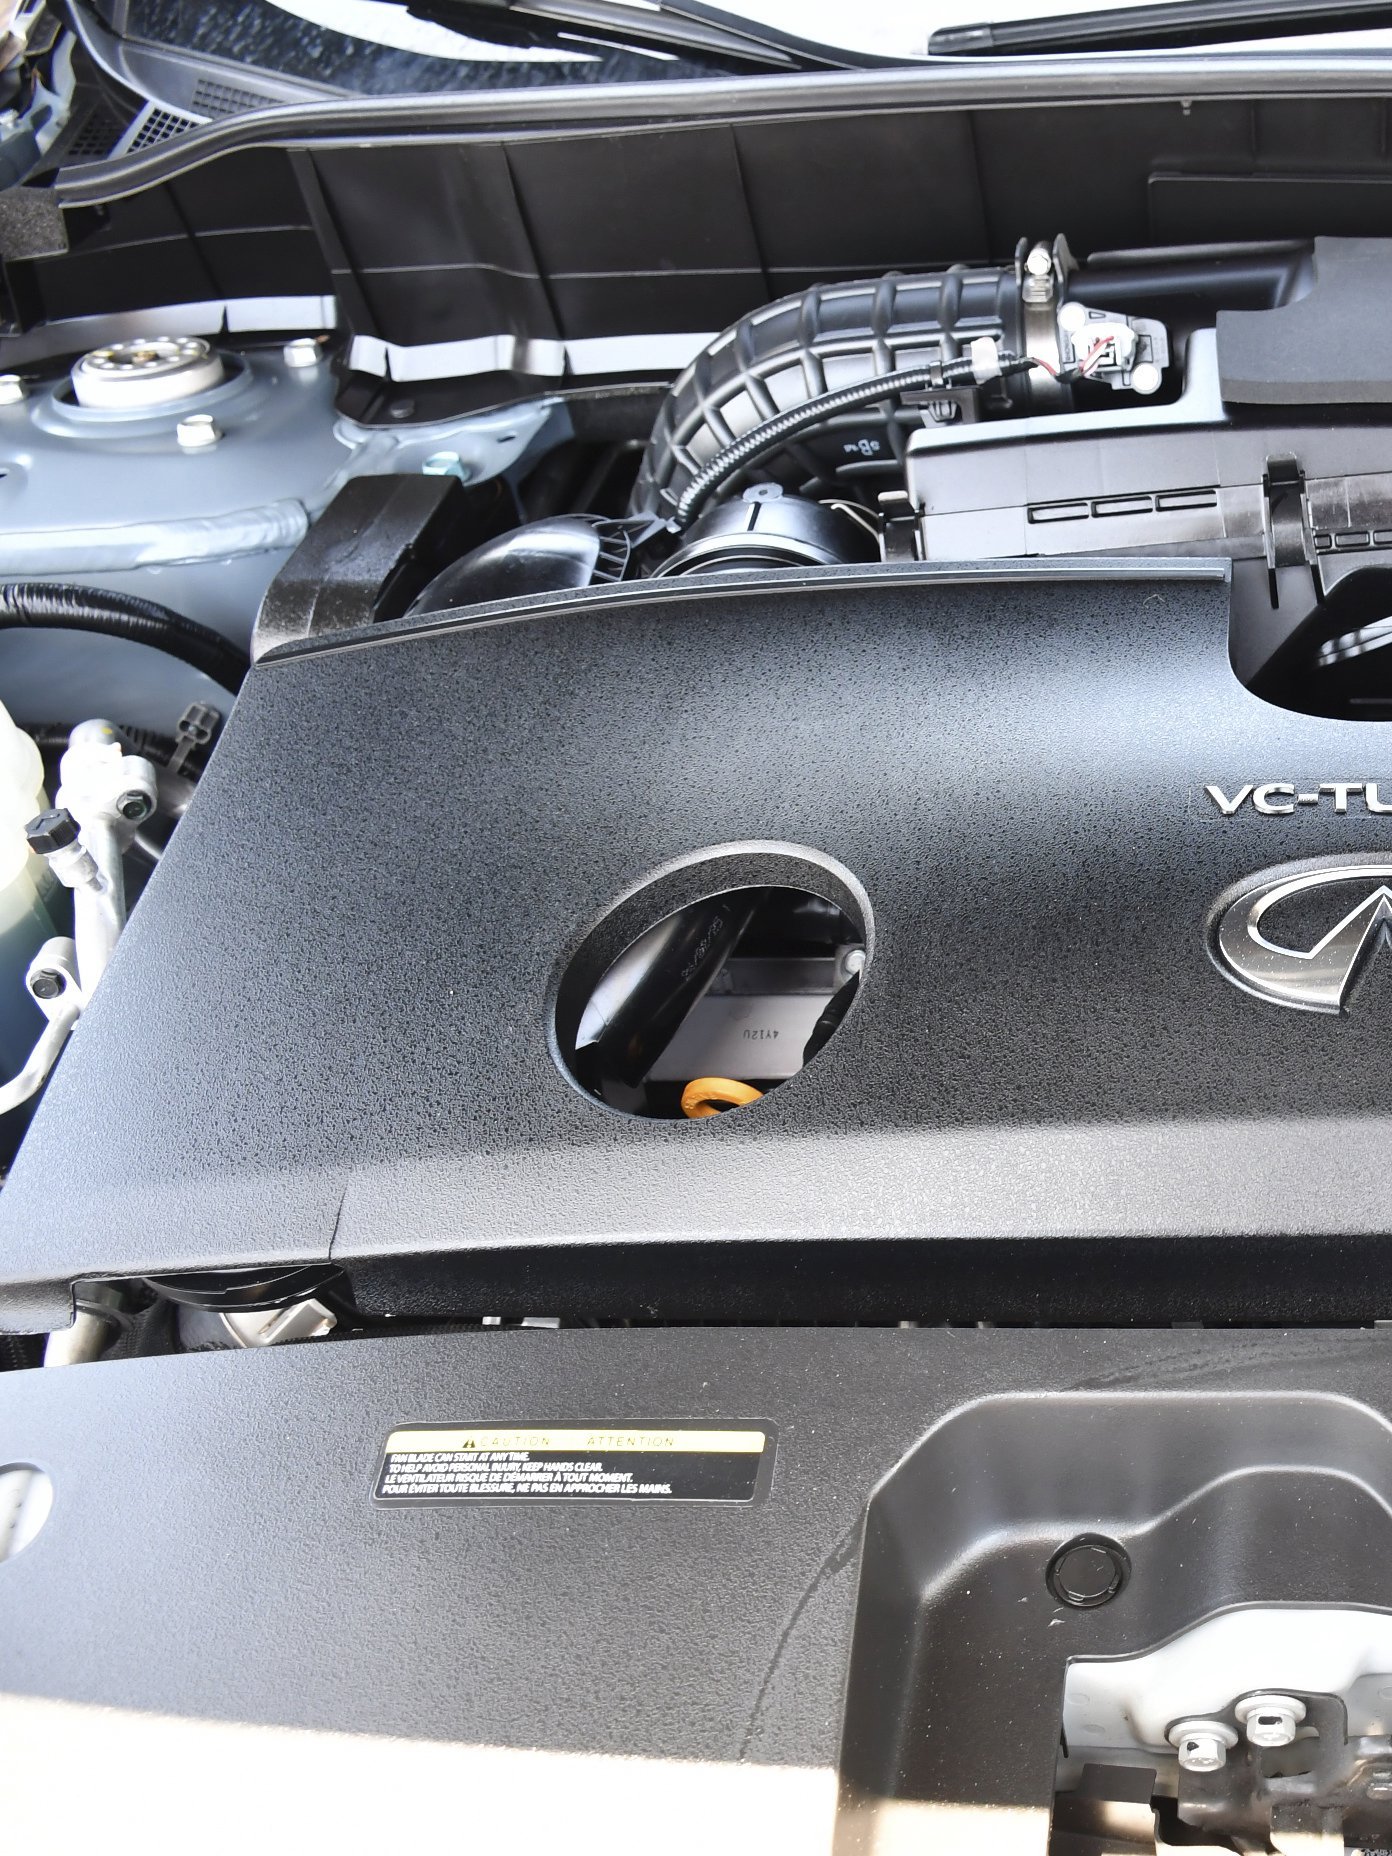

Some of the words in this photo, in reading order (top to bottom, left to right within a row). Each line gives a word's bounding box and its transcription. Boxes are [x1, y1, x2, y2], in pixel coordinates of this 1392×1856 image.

[481, 1436, 549, 1447] CAUTION
[587, 1436, 674, 1447] ATTENTION
[391, 1454, 408, 1463] FAN
[408, 1453, 435, 1463] BLADE
[434, 1453, 454, 1462] CAN
[453, 1452, 478, 1462] START
[478, 1452, 490, 1461] AT
[489, 1452, 510, 1461] ANY
[389, 1463, 401, 1473] TO
[401, 1463, 423, 1473] HELP
[422, 1463, 449, 1472] AVOID
[448, 1462, 491, 1472] PERSONAL
[522, 1462, 543, 1472] KEEP
[543, 1462, 574, 1472] HANDS
[385, 1474, 397, 1484] LE
[397, 1473, 455, 1483] VENTILATEUR
[455, 1473, 489, 1483] RISQUE
[488, 1473, 502, 1482] DE
[562, 1473, 589, 1483] TOUT
[382, 1484, 408, 1494] POUR
[439, 1483, 470, 1493] TOUTE
[516, 1483, 530, 1493] NE
[530, 1483, 549, 1492] PAS
[549, 1483, 564, 1492] EN
[563, 1483, 621, 1493] APPROCHER
[620, 1484, 638, 1493] LES
